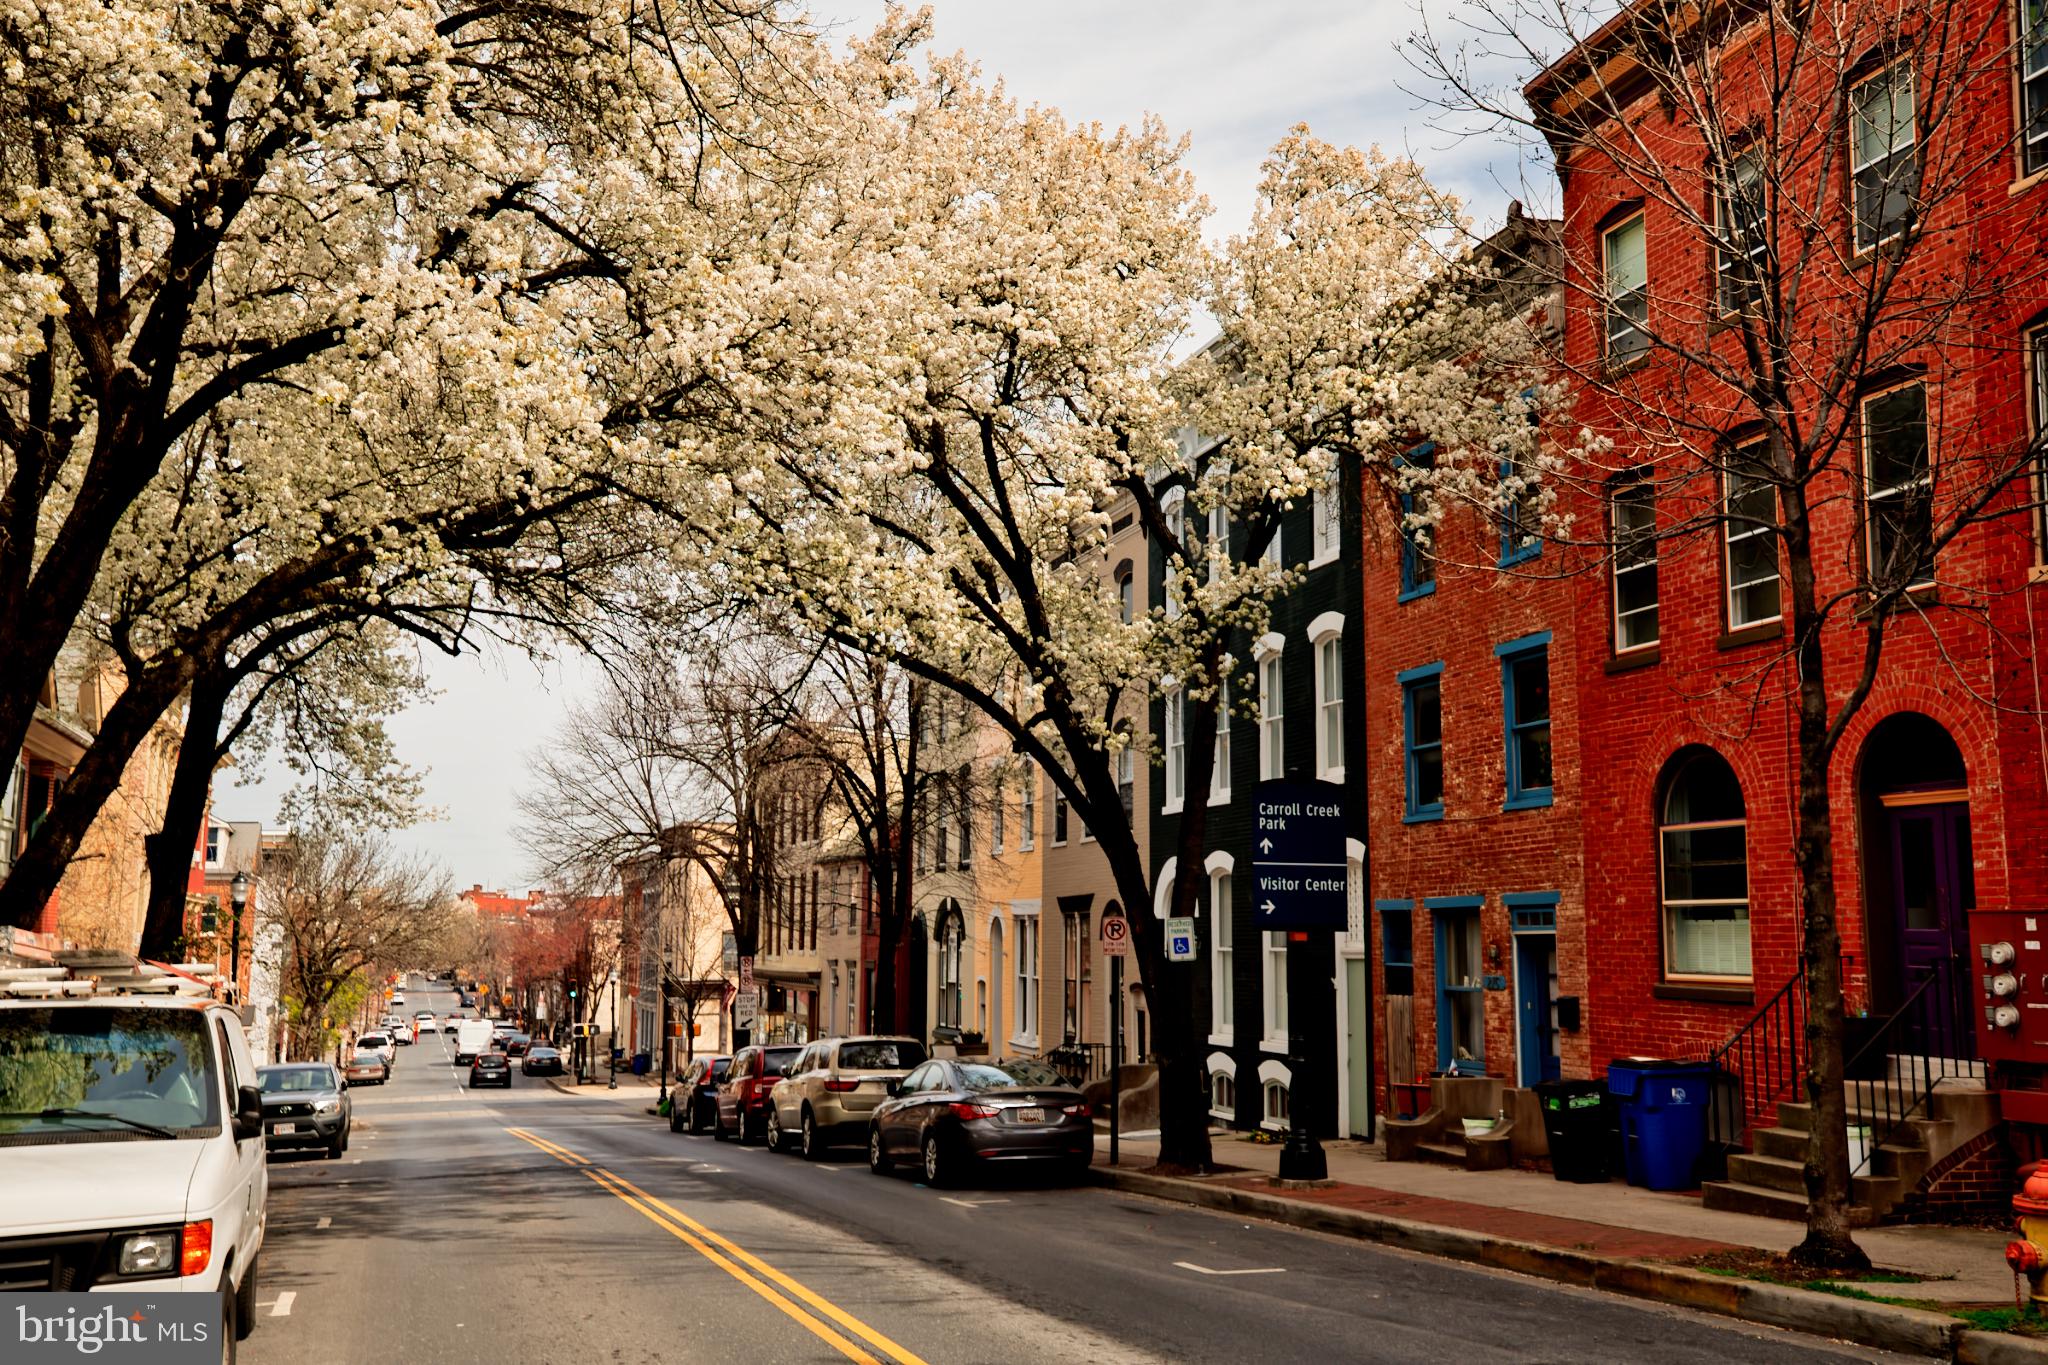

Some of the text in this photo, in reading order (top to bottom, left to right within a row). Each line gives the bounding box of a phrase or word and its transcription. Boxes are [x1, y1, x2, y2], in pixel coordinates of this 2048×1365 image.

[1259, 803, 1340, 817] Carroll Creek
[1259, 817, 1286, 830] Park
[1260, 876, 1345, 891] Visitor Center
[738, 996, 755, 1004] STOP
